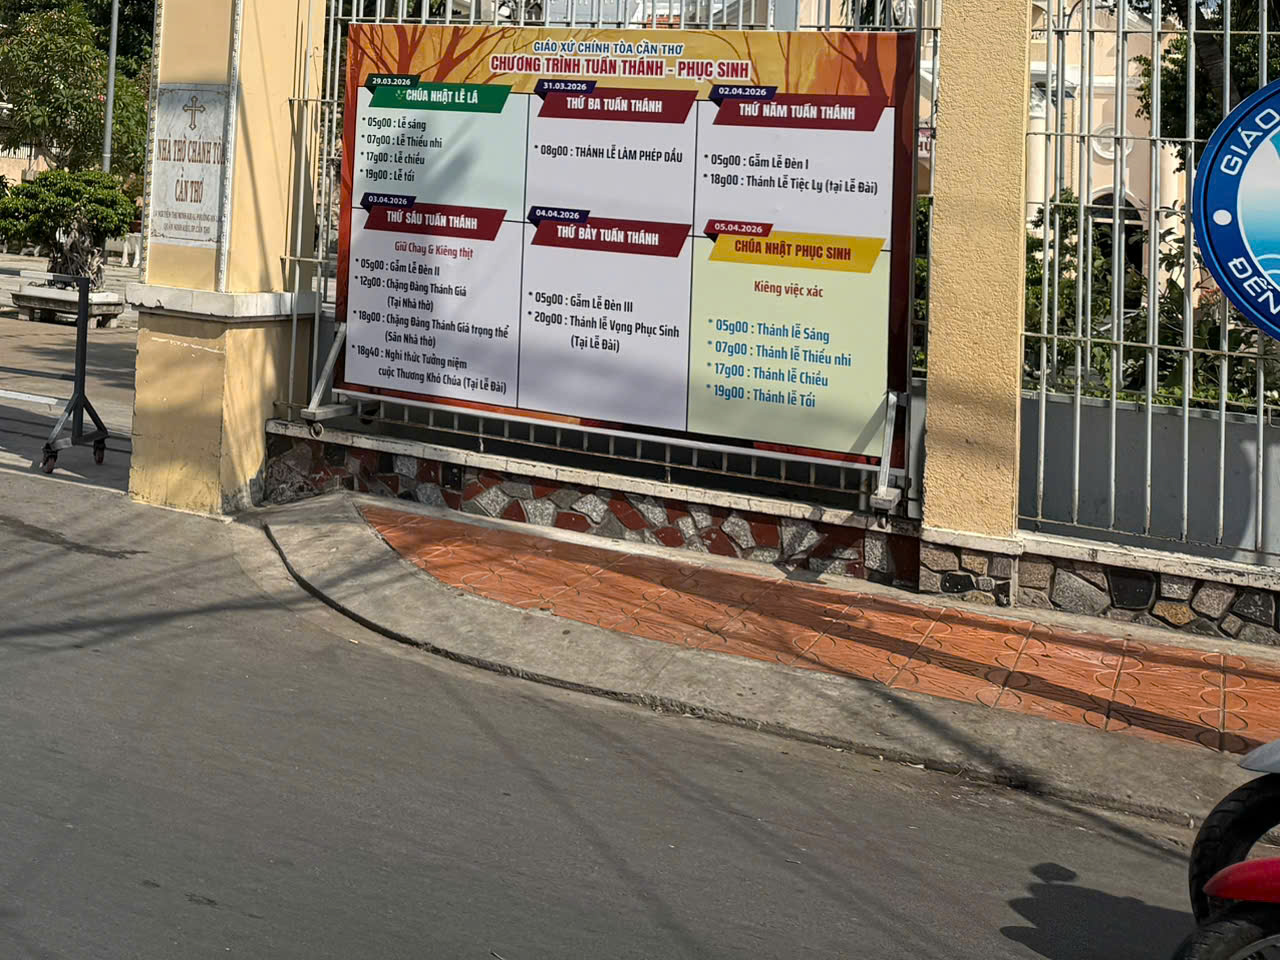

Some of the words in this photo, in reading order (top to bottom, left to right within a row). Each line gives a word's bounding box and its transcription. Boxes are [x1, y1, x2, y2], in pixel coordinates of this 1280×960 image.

[534, 40, 557, 52] GIÁO
[560, 40, 576, 52] XỨ
[578, 40, 609, 53] CHÍNH
[613, 40, 632, 54] TÒA
[636, 40, 658, 54] CẦN
[661, 44, 684, 55] THƠ
[491, 55, 541, 72] CHƯƠNG
[545, 55, 580, 73] TRÌNH
[621, 57, 663, 76] THÁNH
[678, 61, 713, 80] PHỤC
[717, 62, 749, 78] SINH
[372, 78, 411, 86] 29.03.2026
[543, 82, 587, 90] 31.03.2026
[406, 88, 428, 101] CHÚA
[431, 88, 453, 104] NHẬT
[455, 88, 465, 103] LỄ
[467, 90, 478, 103] LÁ
[718, 87, 767, 96] 02.04.2026
[566, 95, 586, 109] THỨ
[588, 97, 601, 110] BA
[630, 98, 662, 112] THÁNH
[739, 101, 760, 116] THỨ
[763, 102, 788, 117] NĂM
[820, 104, 855, 120] THÁNH
[367, 117, 392, 129] 05g00
[398, 116, 406, 128] Lễ
[408, 119, 426, 132] sáng
[188, 134, 211, 164] CHÁNH
[367, 134, 390, 146] 07g00
[397, 134, 405, 146] Lễ
[407, 135, 428, 147] Thiếu
[430, 138, 442, 148] nhi
[1220, 108, 1280, 176] GIÁO
[366, 151, 388, 164] 17g00
[394, 151, 403, 163] Lễ
[541, 145, 568, 158] 08g00
[575, 145, 604, 159] THÁNH
[606, 144, 616, 159] LỄ
[618, 147, 637, 160] LÀM
[639, 148, 662, 161] PHÉP
[711, 154, 741, 168] 05g00
[749, 153, 769, 168] Gẫm
[772, 154, 782, 168] Lễ
[785, 157, 803, 169] Đèn
[365, 169, 387, 181] 19g00
[394, 168, 403, 181] Lễ
[710, 173, 738, 187] 18g00
[746, 175, 775, 188] Thánh
[777, 175, 788, 189] Lễ
[791, 178, 810, 192] Tiệc
[812, 179, 823, 193] Ly
[825, 179, 843, 194] (tại
[845, 178, 856, 193] Lễ
[858, 181, 878, 196] Đài)
[368, 195, 408, 205] 03.04.2026
[386, 209, 404, 223] THỨ
[406, 210, 422, 224] SÁU
[449, 214, 478, 230] THÁNH
[536, 209, 580, 219] 04.04.2026
[557, 224, 576, 239] THỨ
[579, 224, 597, 240] BẢY
[627, 229, 659, 245] THÁNH
[714, 223, 763, 234] 05.04.2026
[409, 242, 426, 256] Chay
[435, 245, 457, 259] Kiêng
[459, 247, 473, 260] thịt
[735, 238, 762, 254] CHÚA
[765, 240, 792, 258] NHẬT
[795, 244, 823, 261] PHỤC
[826, 247, 851, 261] SINH
[361, 259, 384, 271] 05g00
[390, 260, 407, 273] Gẫm
[408, 261, 417, 274] Lễ
[418, 264, 432, 275] Đèn
[360, 276, 381, 289] 12g00
[387, 278, 408, 293] Chặng
[430, 283, 453, 296] Thánh
[455, 286, 467, 297] Giá
[754, 280, 782, 296] Kiêng
[784, 282, 804, 298] việc
[806, 284, 823, 298] xác
[388, 296, 401, 309] (Tại
[403, 298, 417, 309] Nhà
[535, 292, 563, 306] 05g00
[570, 293, 590, 308] Gẫm
[592, 296, 602, 309] Lễ
[604, 299, 621, 311] Đèn
[359, 310, 381, 323] 18g00
[387, 313, 409, 328] Chặng
[432, 319, 456, 332] Thánh
[457, 322, 470, 333] Giá
[471, 325, 493, 338] trọng
[534, 311, 563, 326] 20g00
[570, 315, 597, 329] Thánh
[599, 316, 608, 330] lễ
[610, 320, 633, 335] Vọng
[635, 322, 657, 337] Phục
[659, 324, 679, 338] Sinh
[716, 319, 748, 335] 05g00
[757, 322, 789, 338] Thánh
[791, 323, 801, 339] lễ
[804, 327, 830, 345] Sáng
[403, 333, 418, 345] Nhà
[570, 334, 588, 350] (Tại
[590, 335, 600, 349] Lễ
[602, 338, 620, 353] Đài)
[357, 345, 380, 358] 18g40
[385, 349, 403, 361] Nghi
[404, 350, 420, 363] thức
[422, 353, 445, 368] Tưởng
[447, 357, 467, 370] niệm
[715, 341, 747, 357] 07g00
[756, 344, 788, 360] Thánh
[791, 345, 800, 361] lễ
[802, 348, 831, 364] Thiếu
[834, 353, 851, 367] nhi
[378, 366, 395, 379] cuộc
[396, 368, 425, 384] Thương
[426, 372, 441, 384] Khó
[443, 374, 461, 386] Chúa
[463, 377, 478, 391] (Tại
[480, 377, 489, 390] Lễ
[491, 381, 507, 395] Đài)
[715, 362, 744, 378] 17g00
[753, 367, 785, 382] Thánh
[788, 367, 797, 383] lễ
[714, 384, 744, 400] 19g00
[753, 388, 785, 404] Thánh
[787, 389, 797, 405] lễ
[800, 392, 815, 408] Tối
